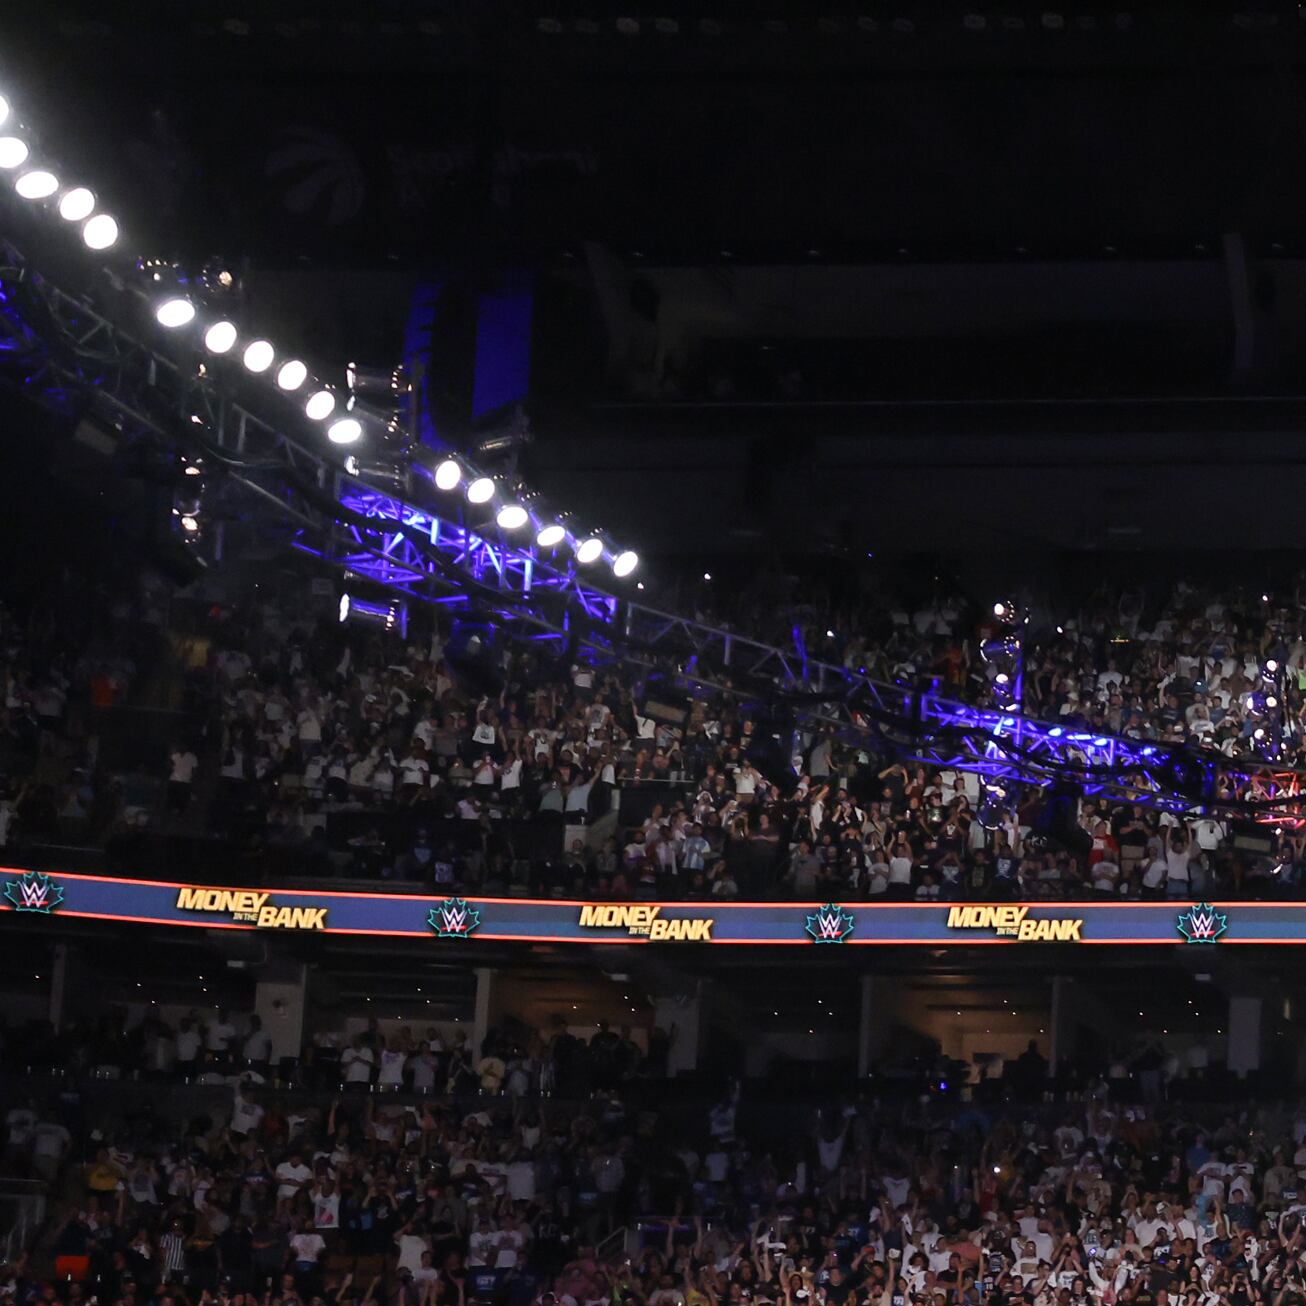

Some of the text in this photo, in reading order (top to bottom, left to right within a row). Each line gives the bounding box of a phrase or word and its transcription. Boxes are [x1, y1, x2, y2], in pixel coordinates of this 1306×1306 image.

[177, 887, 269, 913] MONEY
[257, 907, 327, 929] BANK
[579, 906, 661, 926] MONEY
[650, 919, 713, 940] BANK
[947, 906, 1029, 927] MONEY
[1018, 920, 1082, 940] BANK
